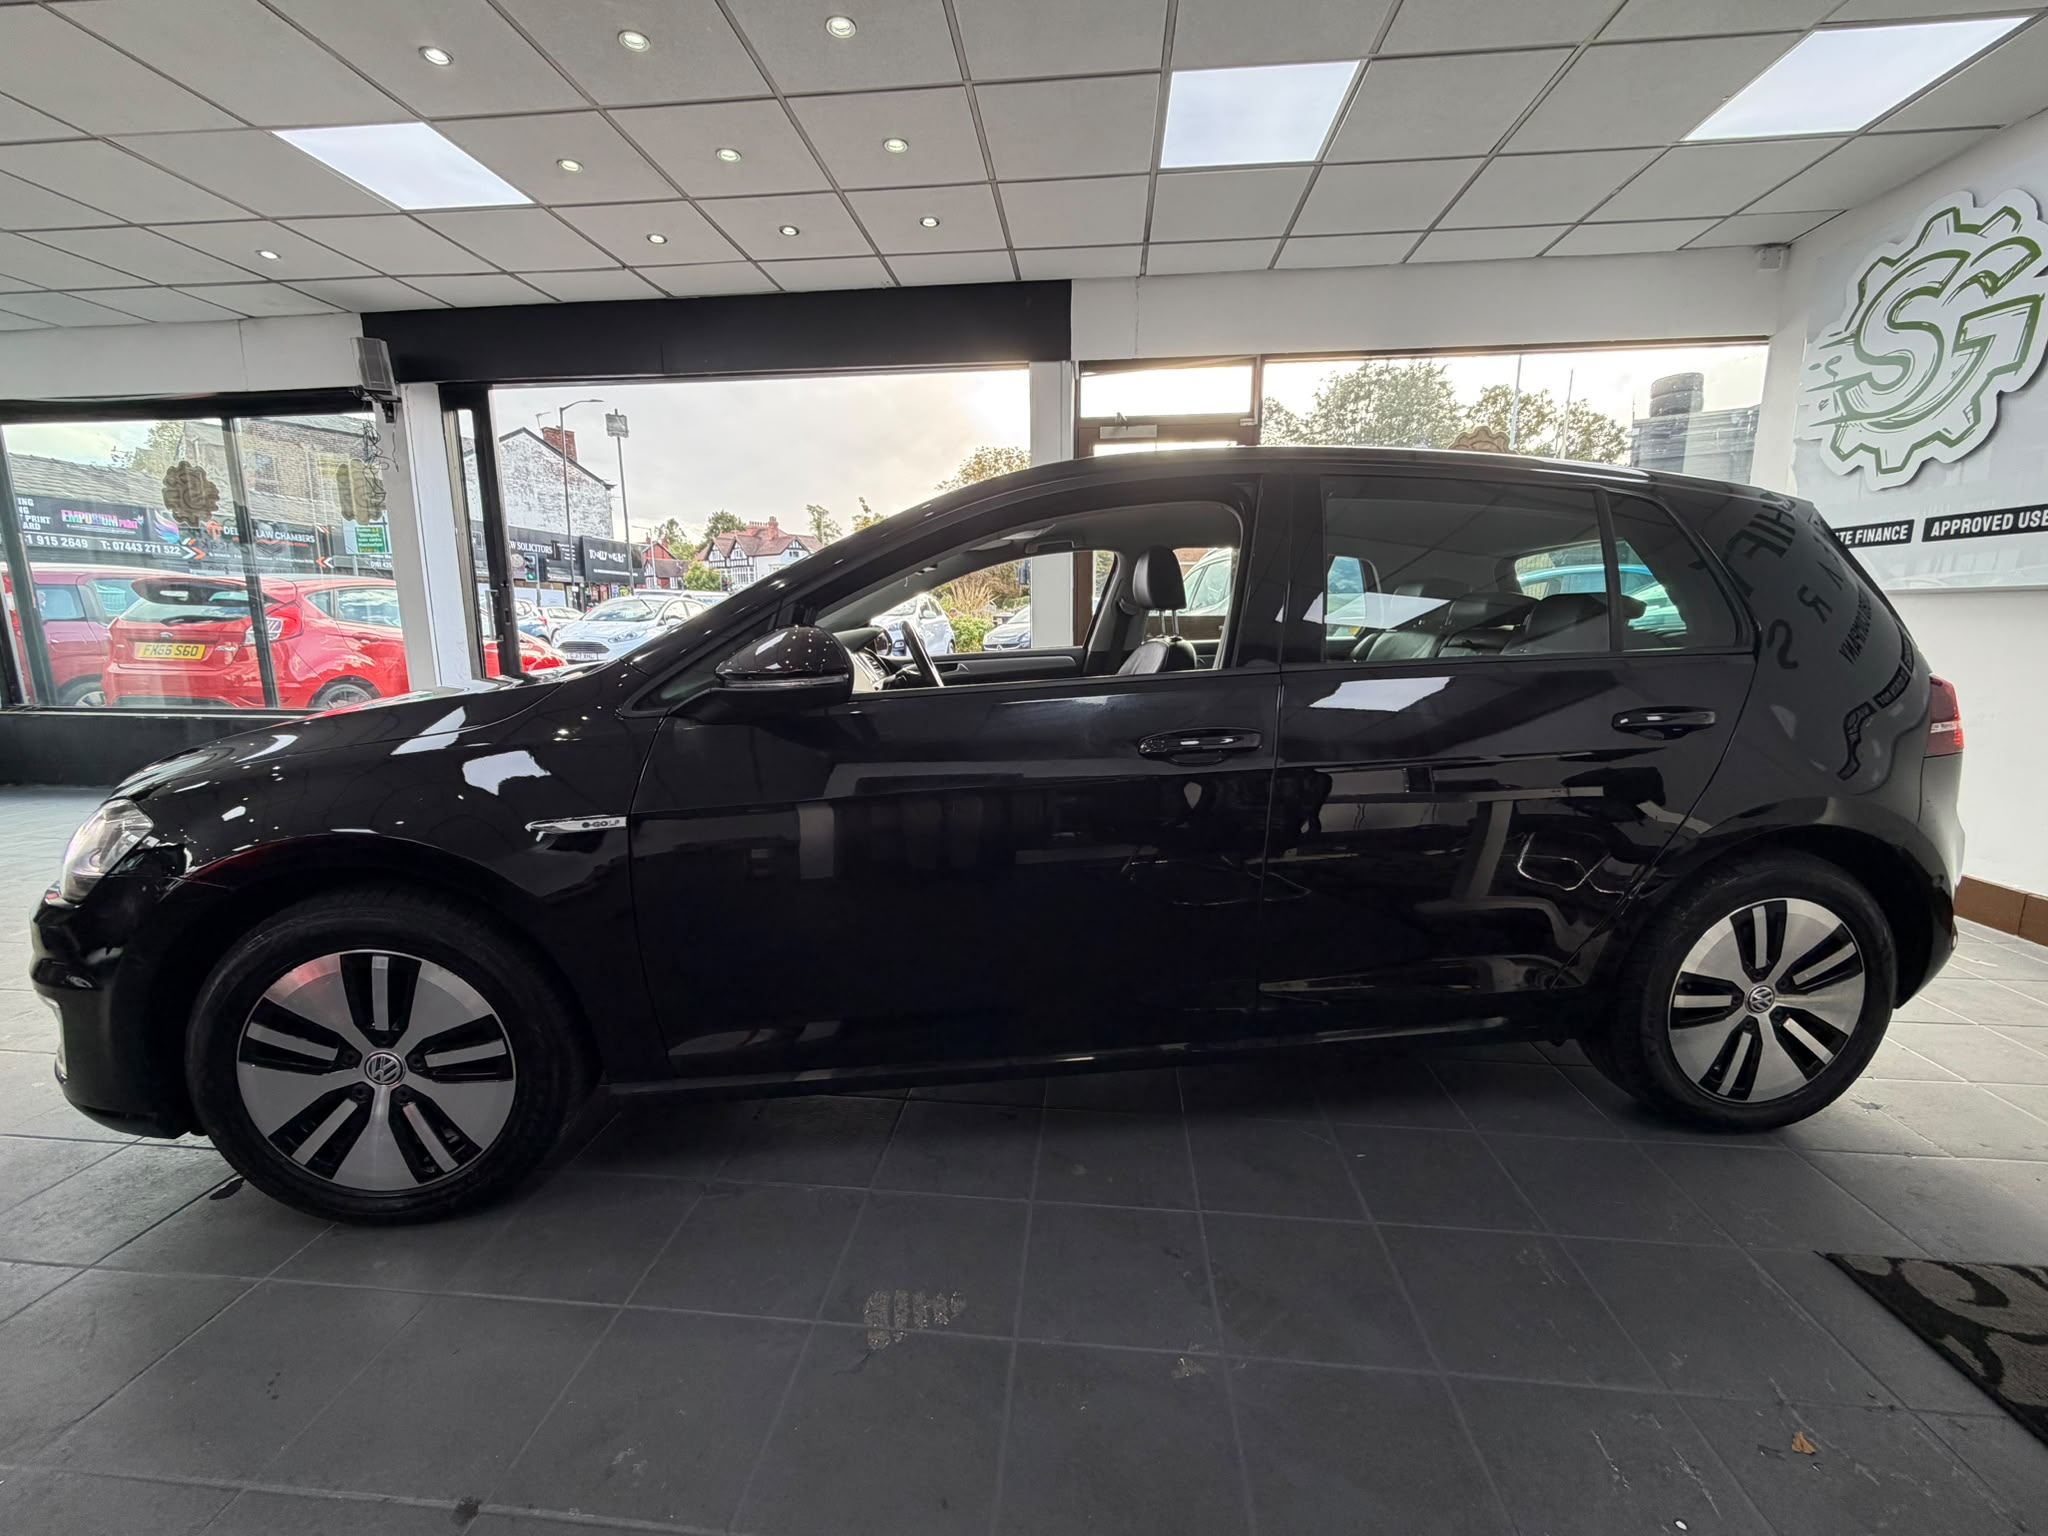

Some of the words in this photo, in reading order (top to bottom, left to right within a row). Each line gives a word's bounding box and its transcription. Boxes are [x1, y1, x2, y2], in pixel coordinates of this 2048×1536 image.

[1930, 512, 2014, 537] APPROVED
[255, 529, 273, 539] LAW
[274, 531, 316, 543] CHAMBERS
[1854, 524, 1910, 544] FINANCE
[36, 535, 58, 546] 915
[60, 537, 89, 549] 2649
[112, 541, 143, 553] 07443
[144, 544, 161, 554] 271
[163, 545, 181, 555] 522
[517, 542, 553, 554] SOLICITORS
